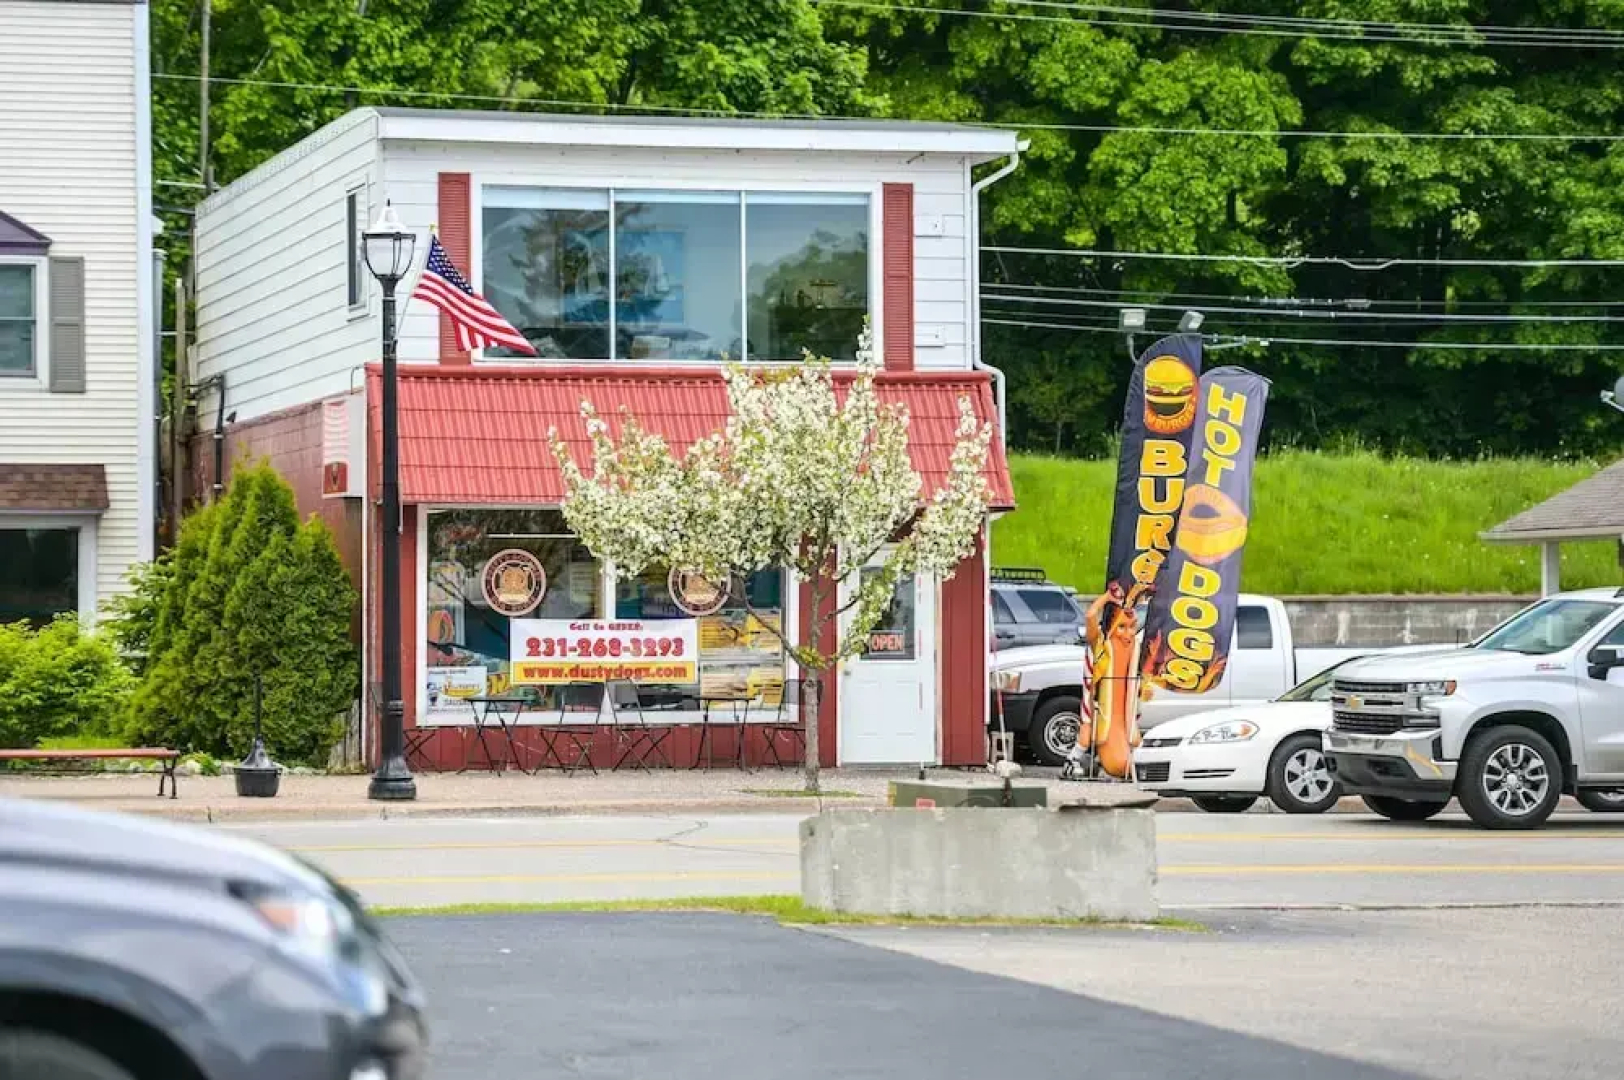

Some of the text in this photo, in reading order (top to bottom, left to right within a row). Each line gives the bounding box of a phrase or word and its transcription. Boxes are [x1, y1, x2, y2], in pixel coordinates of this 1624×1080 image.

[1161, 382, 1247, 692] HOT DOGS
[525, 637, 684, 657] 231-268-3293
[871, 634, 904, 650] OPEN
